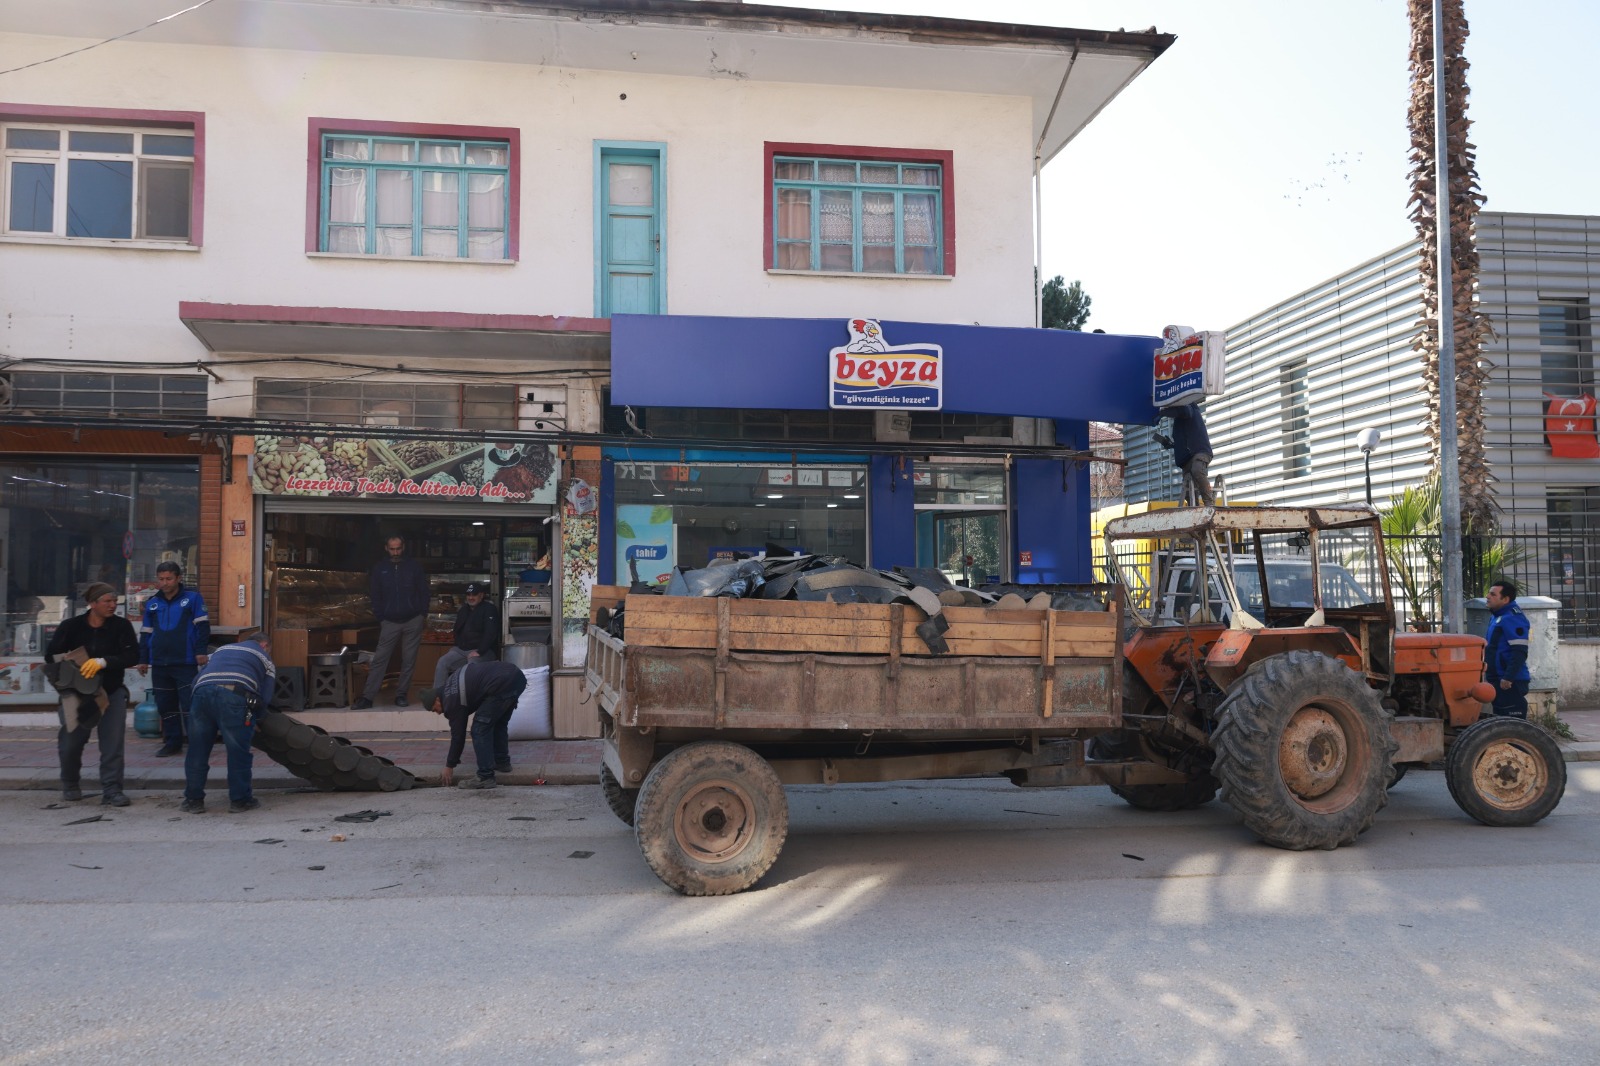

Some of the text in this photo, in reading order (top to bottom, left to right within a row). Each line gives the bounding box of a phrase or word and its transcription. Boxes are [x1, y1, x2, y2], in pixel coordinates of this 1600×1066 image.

[836, 353, 938, 387] beyza
[1154, 354, 1203, 378] beyza
[286, 474, 352, 493] Lezzetin
[357, 477, 395, 493] Tadı
[398, 479, 477, 496] Kalitenin
